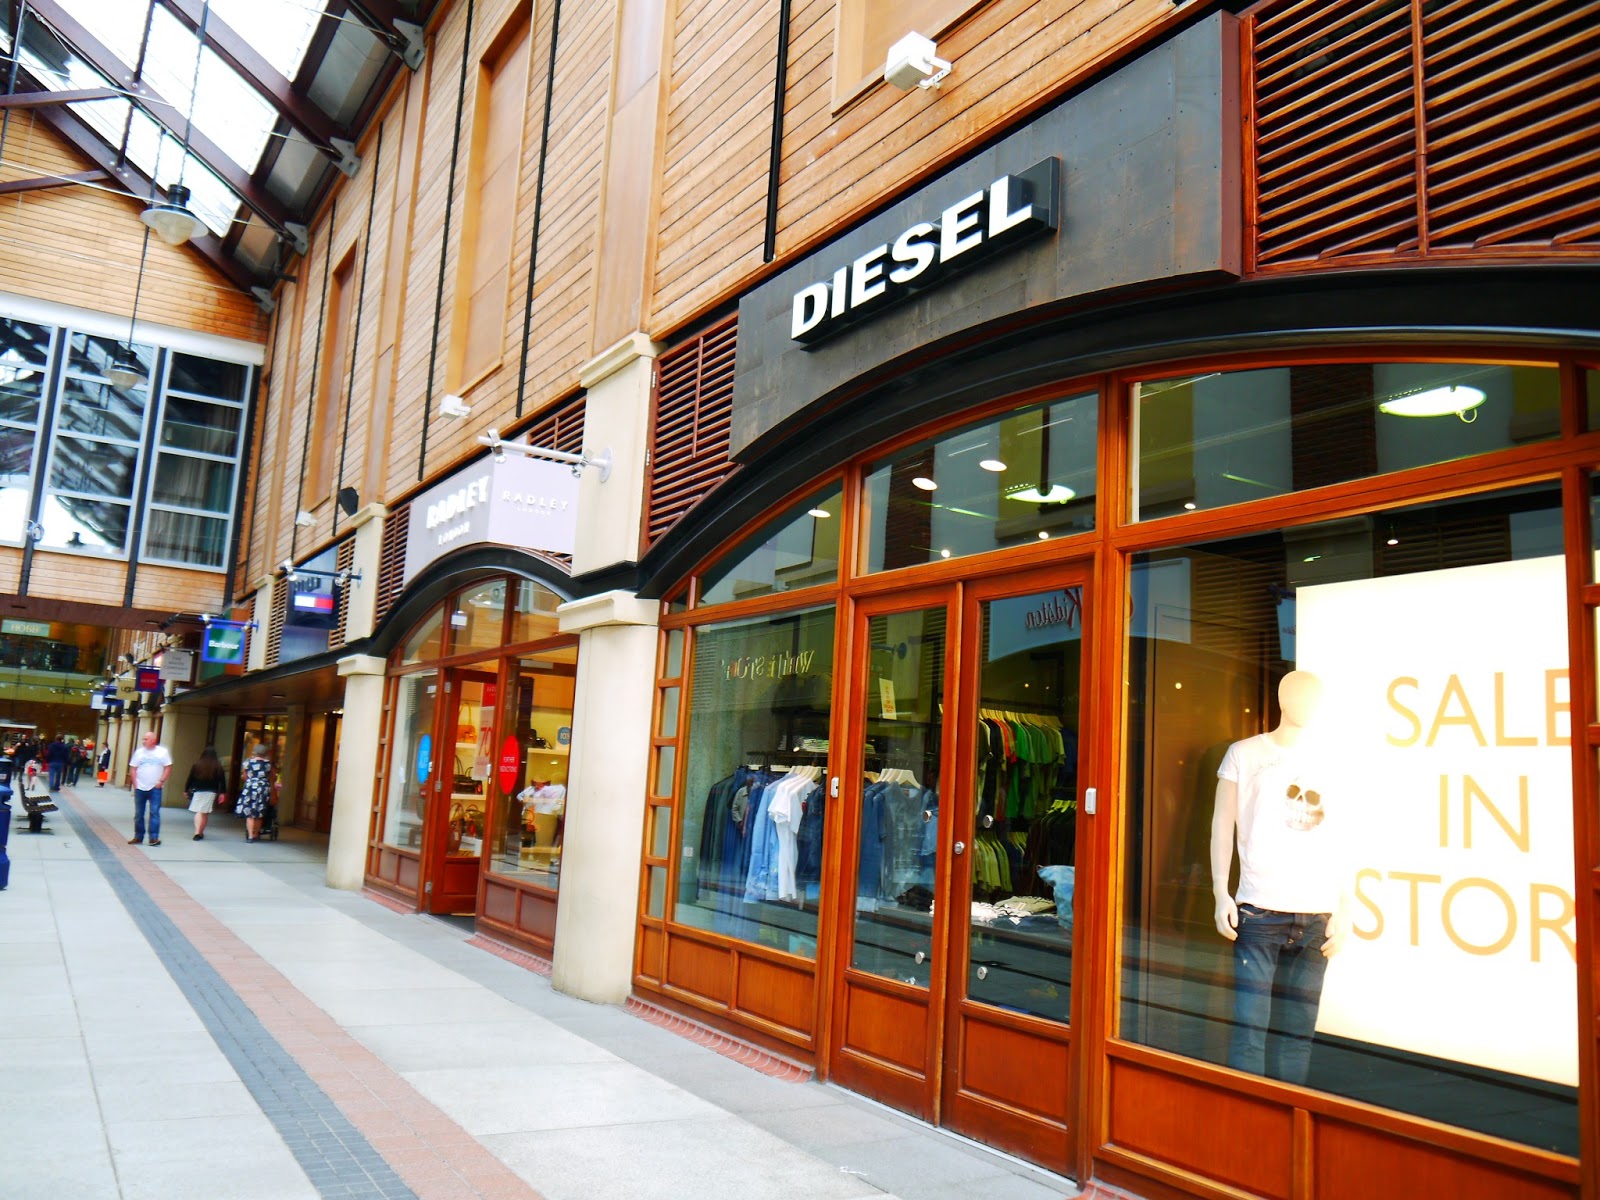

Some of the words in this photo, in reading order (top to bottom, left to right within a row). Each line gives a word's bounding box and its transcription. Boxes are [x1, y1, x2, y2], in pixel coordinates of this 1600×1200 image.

[790, 174, 1033, 341] DIESEL
[426, 475, 490, 529] RADLEY
[503, 490, 569, 511] RADLEY
[208, 640, 240, 650] Barbour
[1385, 668, 1572, 748] SALE
[1439, 774, 1531, 853] IN
